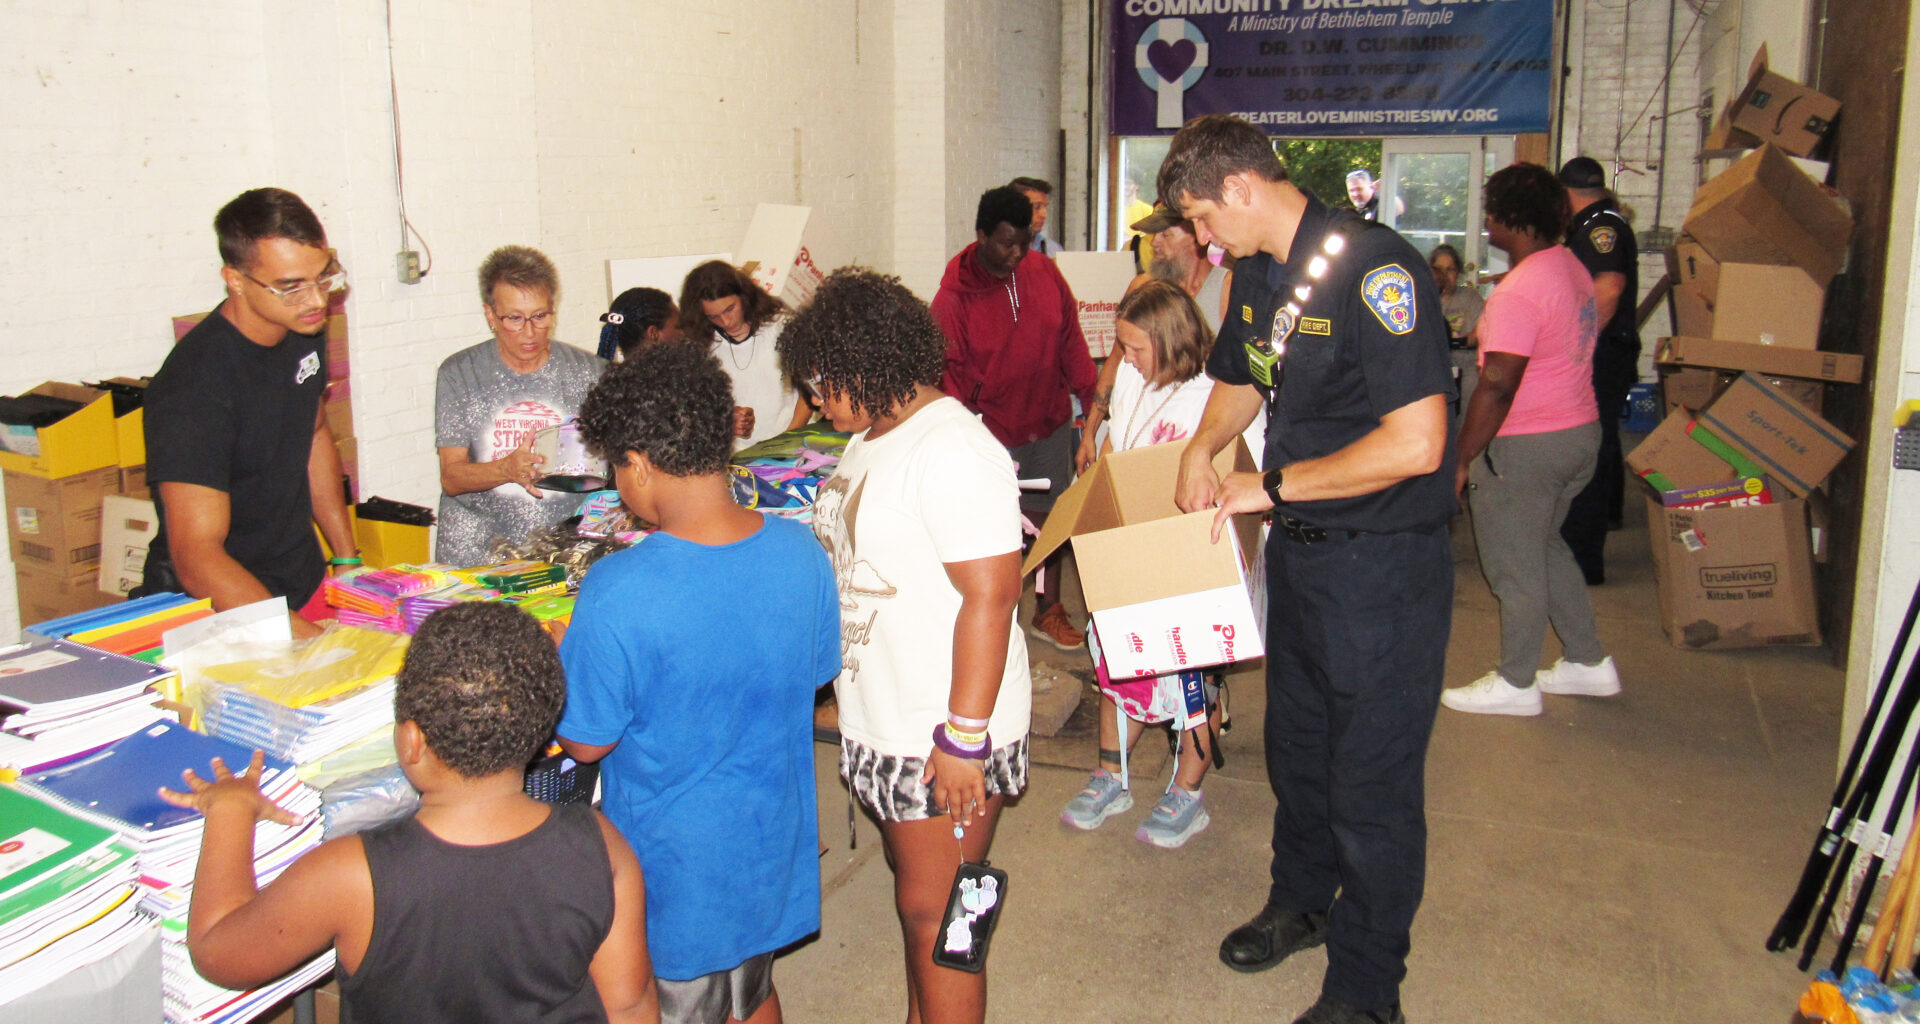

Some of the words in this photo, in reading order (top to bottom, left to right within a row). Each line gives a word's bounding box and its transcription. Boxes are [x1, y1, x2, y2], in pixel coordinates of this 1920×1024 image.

[1125, 0, 1290, 17] COMMUNITY
[1227, 15, 1239, 32] A
[1240, 13, 1301, 34] Ministry
[1301, 11, 1319, 30] of
[1318, 9, 1398, 29] Bethlehem
[1401, 6, 1454, 29] Temple
[495, 418, 516, 428] WEST
[519, 418, 549, 429] VIRGINIA
[1746, 410, 1807, 455] Sport-Tek
[1704, 569, 1772, 582] trueliving
[1706, 590, 1743, 600] Kitchen
[1746, 587, 1773, 599] Towel
[841, 609, 878, 656] gel
[1131, 632, 1143, 653] dle
[1172, 626, 1187, 665] handle
